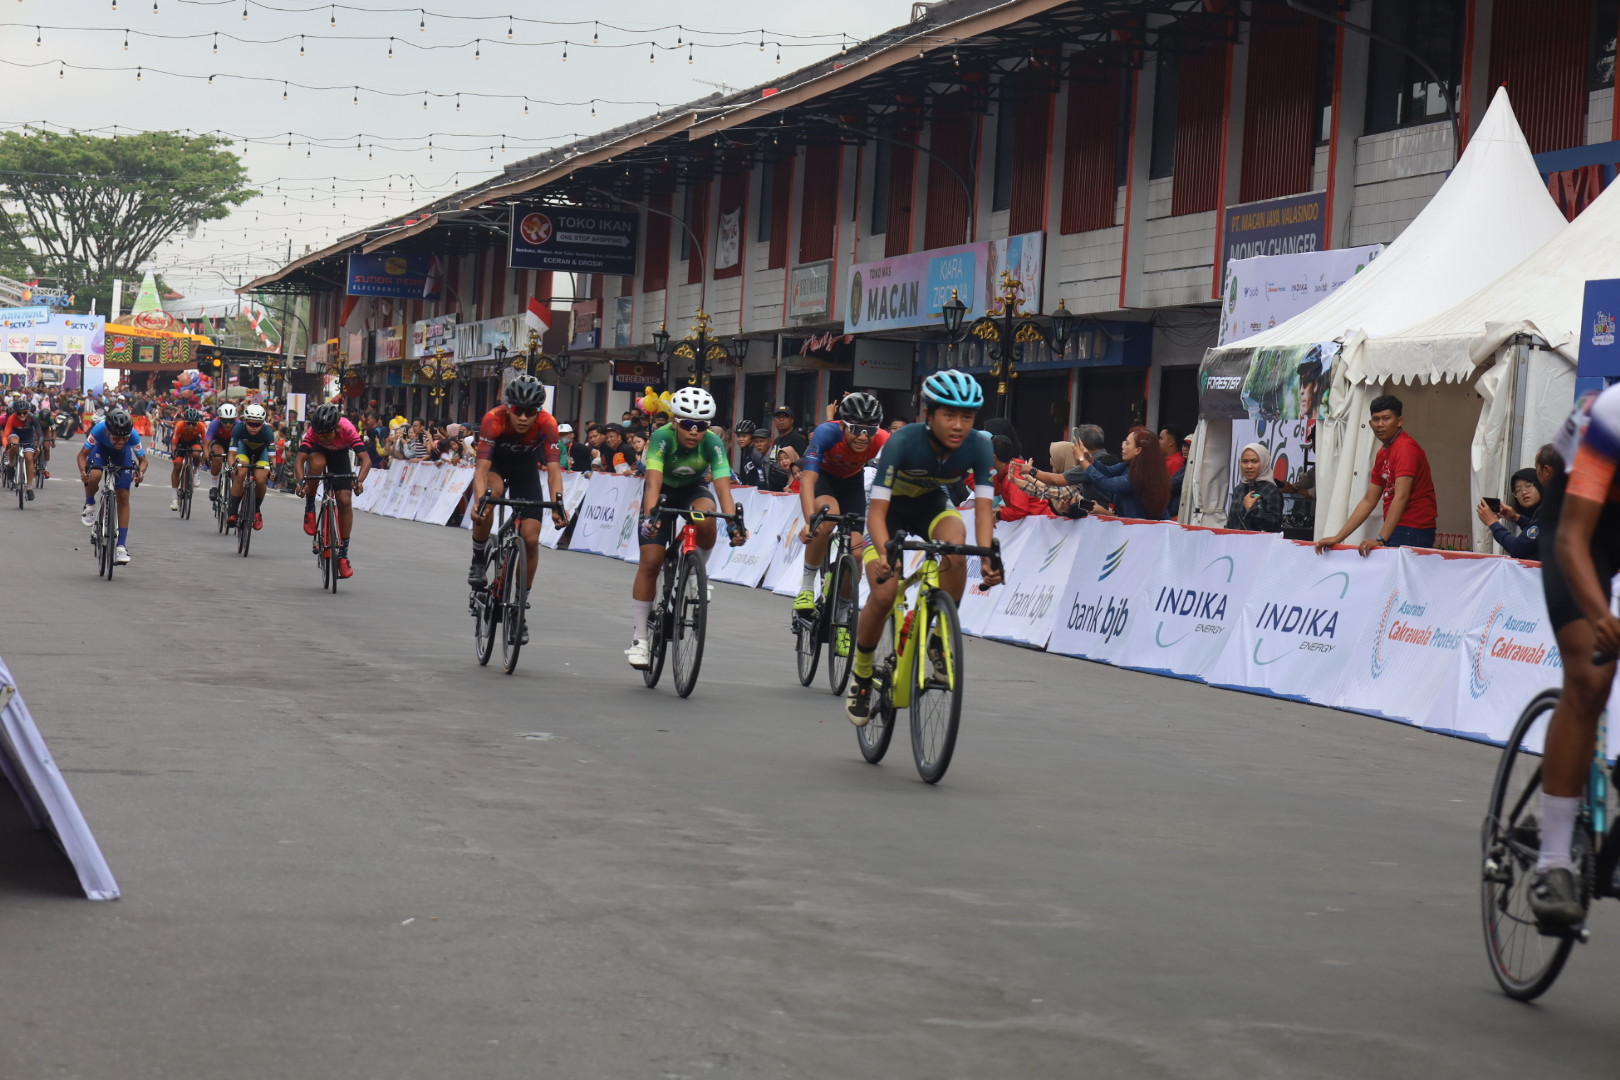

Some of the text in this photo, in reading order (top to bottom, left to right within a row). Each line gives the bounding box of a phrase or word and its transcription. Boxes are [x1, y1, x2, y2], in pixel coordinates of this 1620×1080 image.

[557, 216, 632, 232] TOKO IKAN
[1242, 211, 1264, 231] MACAN
[1265, 208, 1281, 228] JAYA
[1281, 202, 1319, 225] VALASINDO
[591, 236, 622, 244] SHOPPING
[1230, 232, 1317, 261] MONEY CHANGER
[543, 257, 571, 265] ECERAN
[577, 259, 604, 267] GROSIR
[939, 256, 963, 281] KIARA
[353, 275, 393, 285] SUNDA
[869, 266, 892, 280] TOKO MAS
[352, 284, 401, 293] ELECTRONIC
[31, 295, 61, 306] SCTV
[867, 280, 919, 321] MACAN
[70, 322, 88, 330] SCTV
[618, 375, 658, 384] NEDERLAND
[1206, 376, 1242, 390] FORESTER
[584, 504, 615, 522] INDIKA
[1004, 582, 1038, 618] bank
[1029, 584, 1055, 626] bjb
[1155, 586, 1228, 621] INDIKA
[1397, 600, 1428, 617] Asuransi
[1067, 591, 1129, 644] bank bjb
[1256, 601, 1340, 639] INDIKA
[1502, 614, 1540, 634] Asuransi
[1194, 622, 1226, 635] ENERGY
[1388, 618, 1463, 650] Cakrawala Proteksi
[1298, 640, 1337, 653] ENERGY
[1490, 635, 1546, 666] Cakrawala
